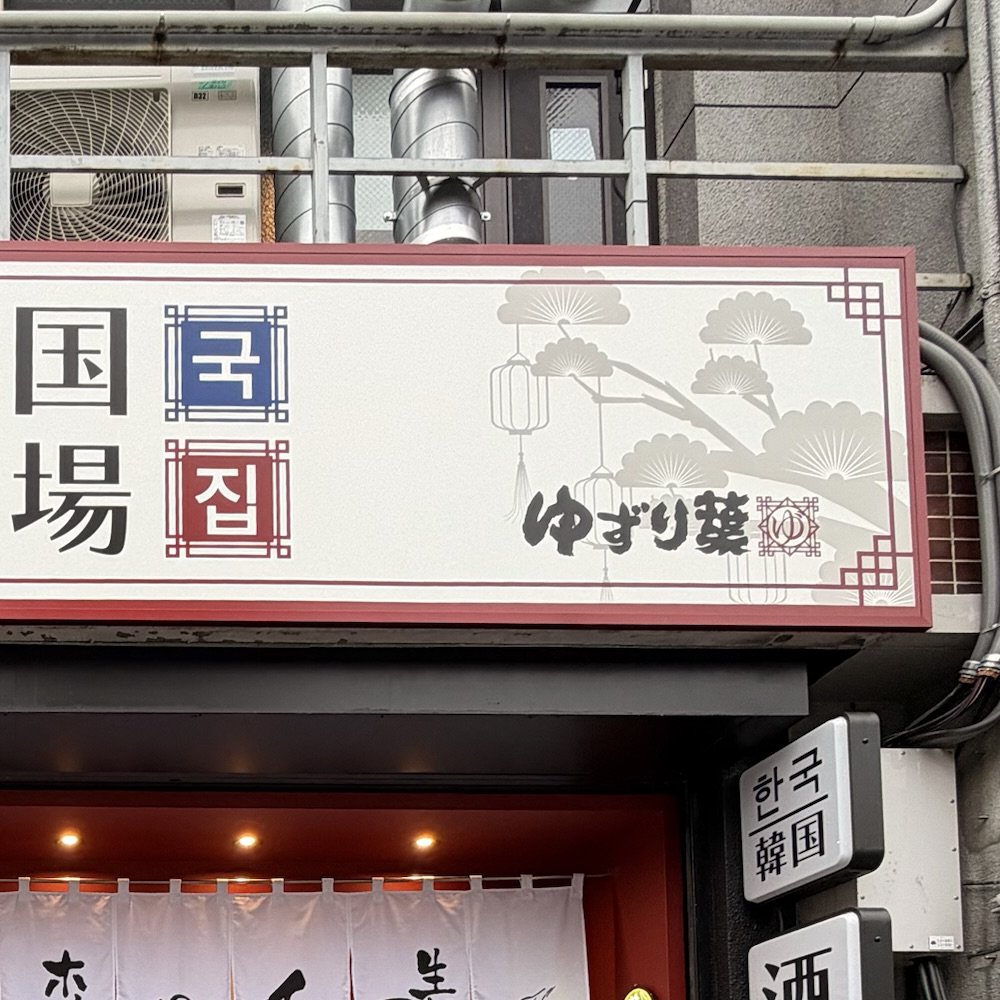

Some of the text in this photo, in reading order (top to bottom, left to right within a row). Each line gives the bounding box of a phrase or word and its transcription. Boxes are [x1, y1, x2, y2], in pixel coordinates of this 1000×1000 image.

[192, 330, 261, 401] 국
[194, 463, 258, 537] 집
[522, 484, 750, 557] ゆずり葉
[752, 746, 824, 822] 한국
[754, 809, 826, 883] 韓国
